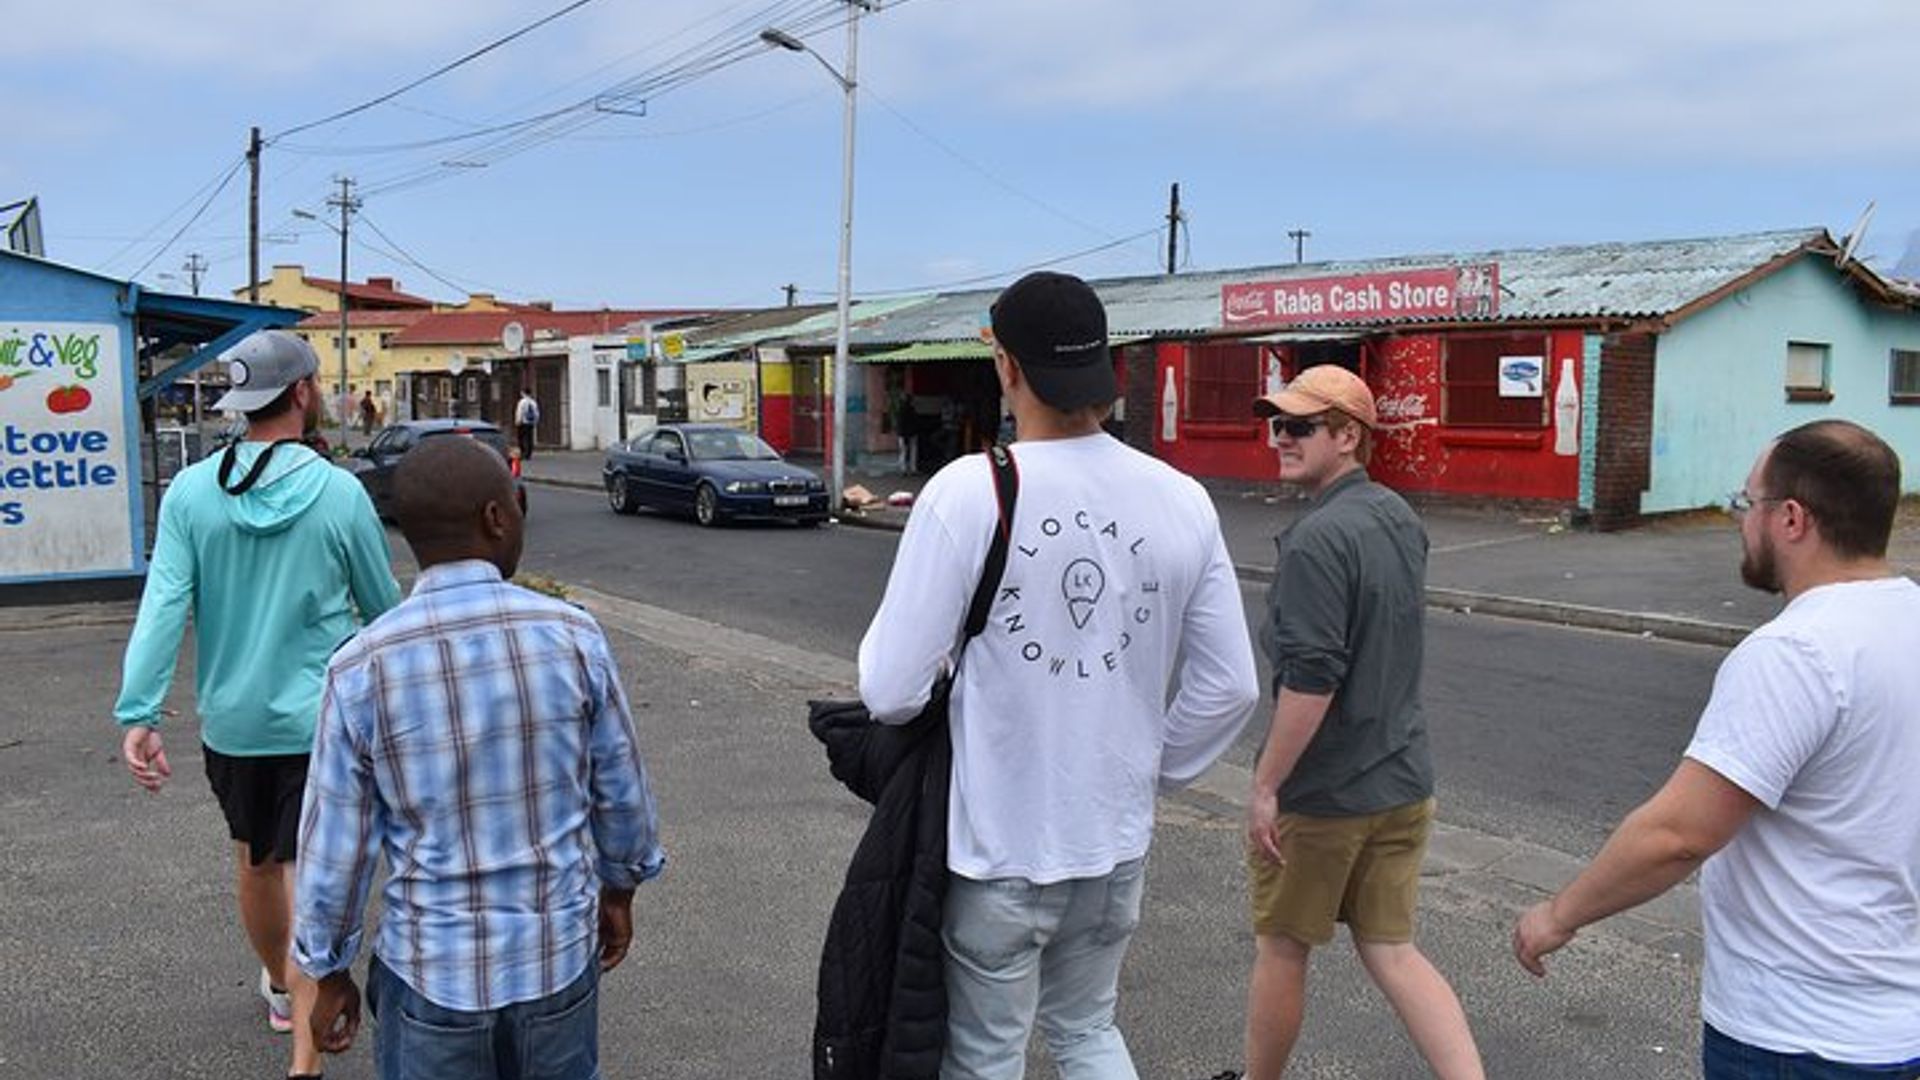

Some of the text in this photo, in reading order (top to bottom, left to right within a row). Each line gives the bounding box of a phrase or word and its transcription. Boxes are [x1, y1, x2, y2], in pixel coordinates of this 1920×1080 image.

[1274, 280, 1449, 315] Raba Cash Store
[28, 332, 55, 368] &
[51, 333, 100, 380] Veg
[0, 425, 109, 456] tove
[1018, 510, 1145, 558] LOCAL
[1074, 573, 1093, 589] LK
